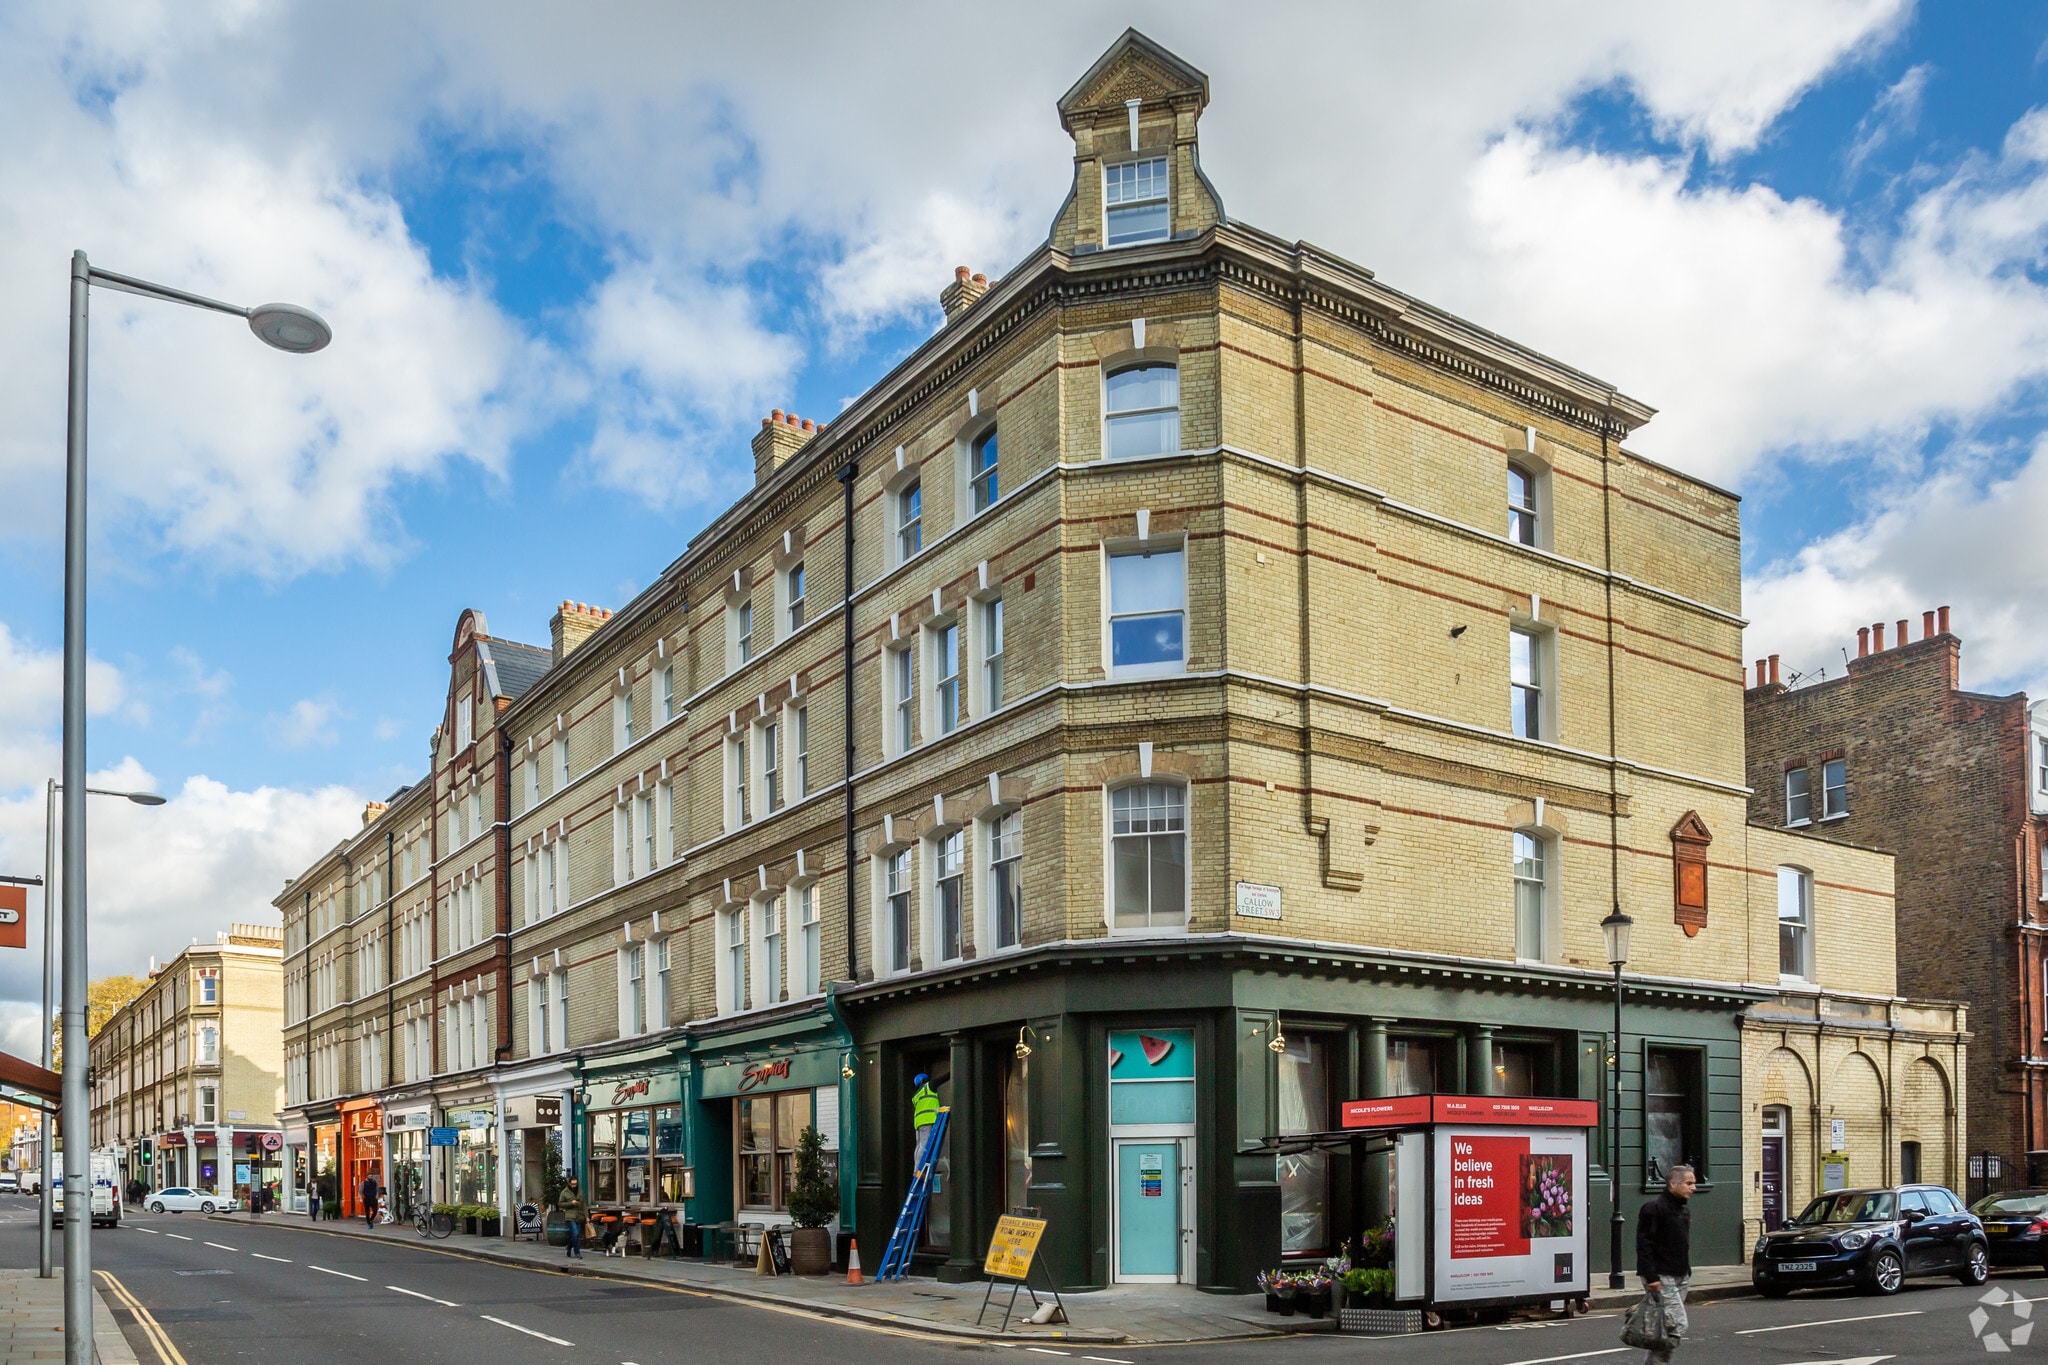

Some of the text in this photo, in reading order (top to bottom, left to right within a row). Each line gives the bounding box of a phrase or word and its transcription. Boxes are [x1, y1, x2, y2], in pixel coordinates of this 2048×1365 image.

[1244, 897, 1273, 907] CALLOW
[1238, 905, 1263, 915] STREET
[1454, 1142, 1472, 1154] We
[1454, 1159, 1492, 1171] believe
[1454, 1175, 1494, 1188] in fresh
[1454, 1192, 1482, 1205] ideas
[1001, 1218, 1043, 1229] ADVANCE WARNING
[1000, 1227, 1036, 1238] ROAD WORKS
[1562, 1266, 1571, 1275] JLL
